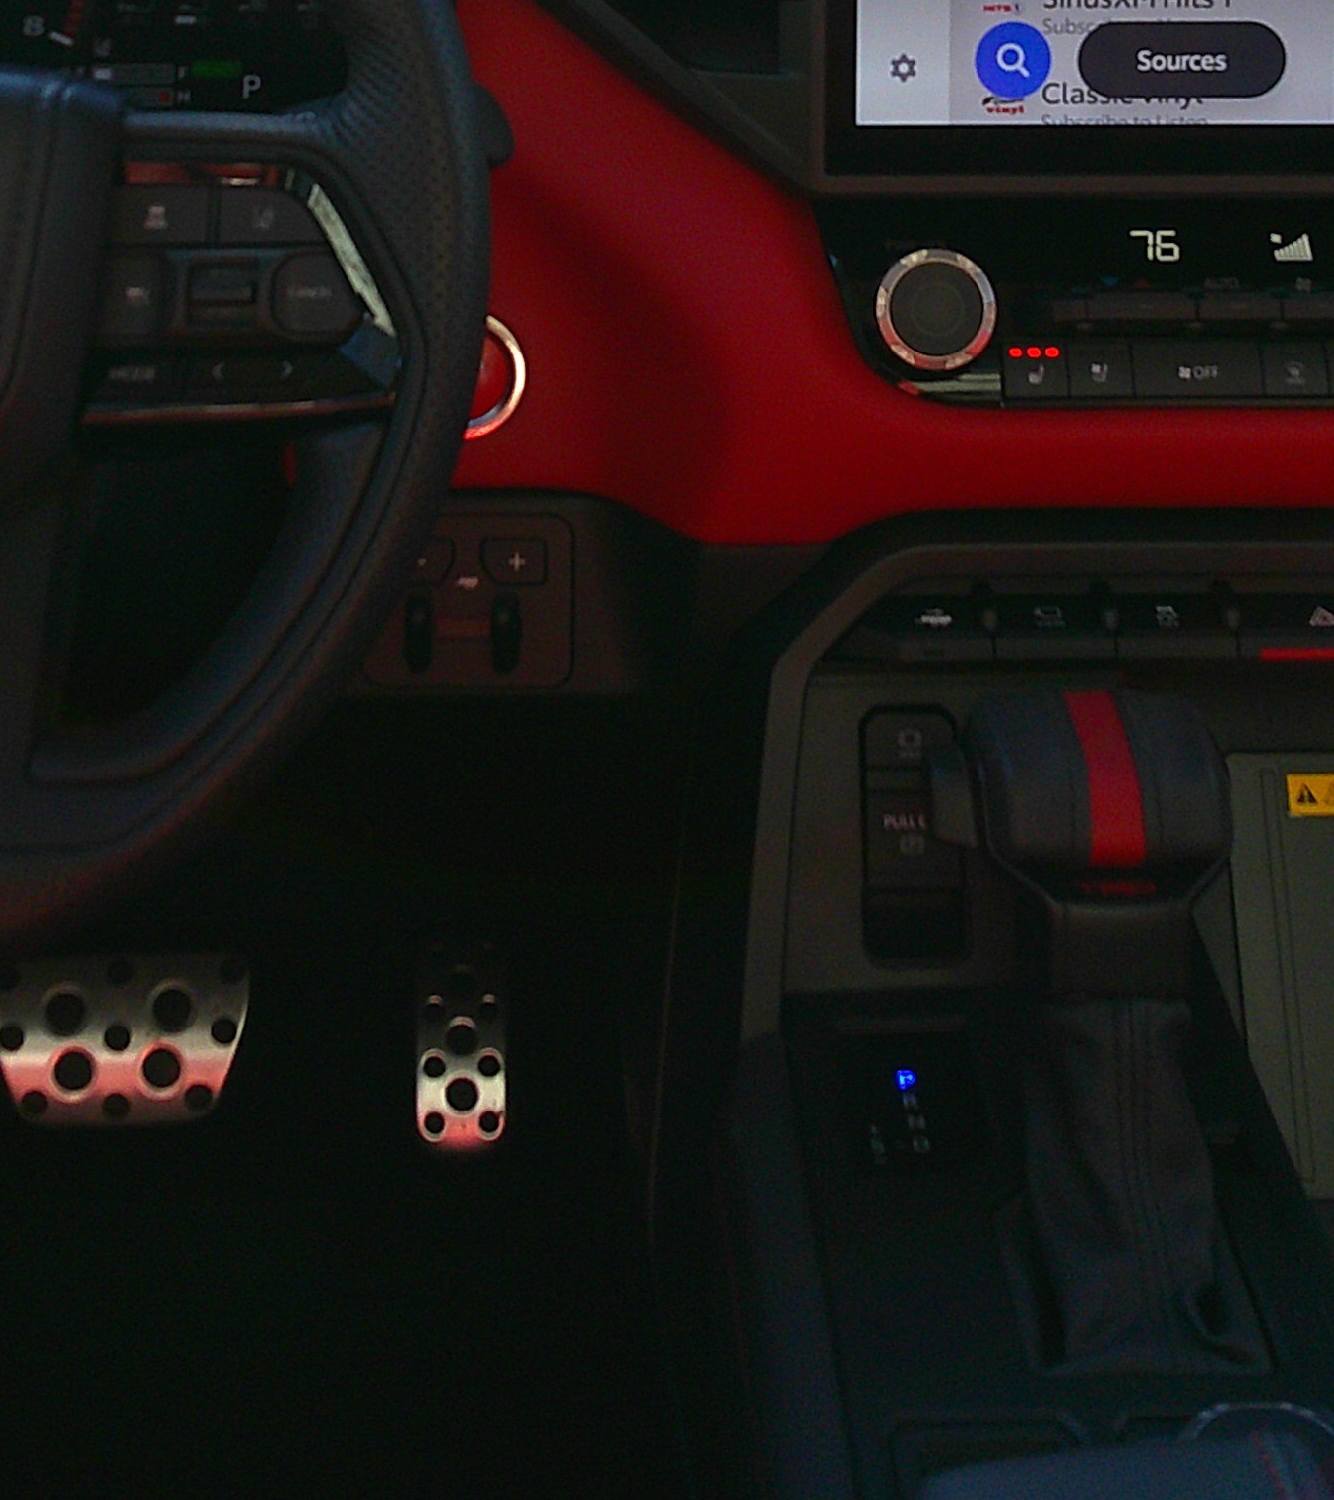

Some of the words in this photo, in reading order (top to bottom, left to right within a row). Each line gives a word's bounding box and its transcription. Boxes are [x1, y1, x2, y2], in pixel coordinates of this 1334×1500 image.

[1136, 49, 1228, 73] Sources
[241, 73, 262, 99] P
[1129, 229, 1181, 262] 76
